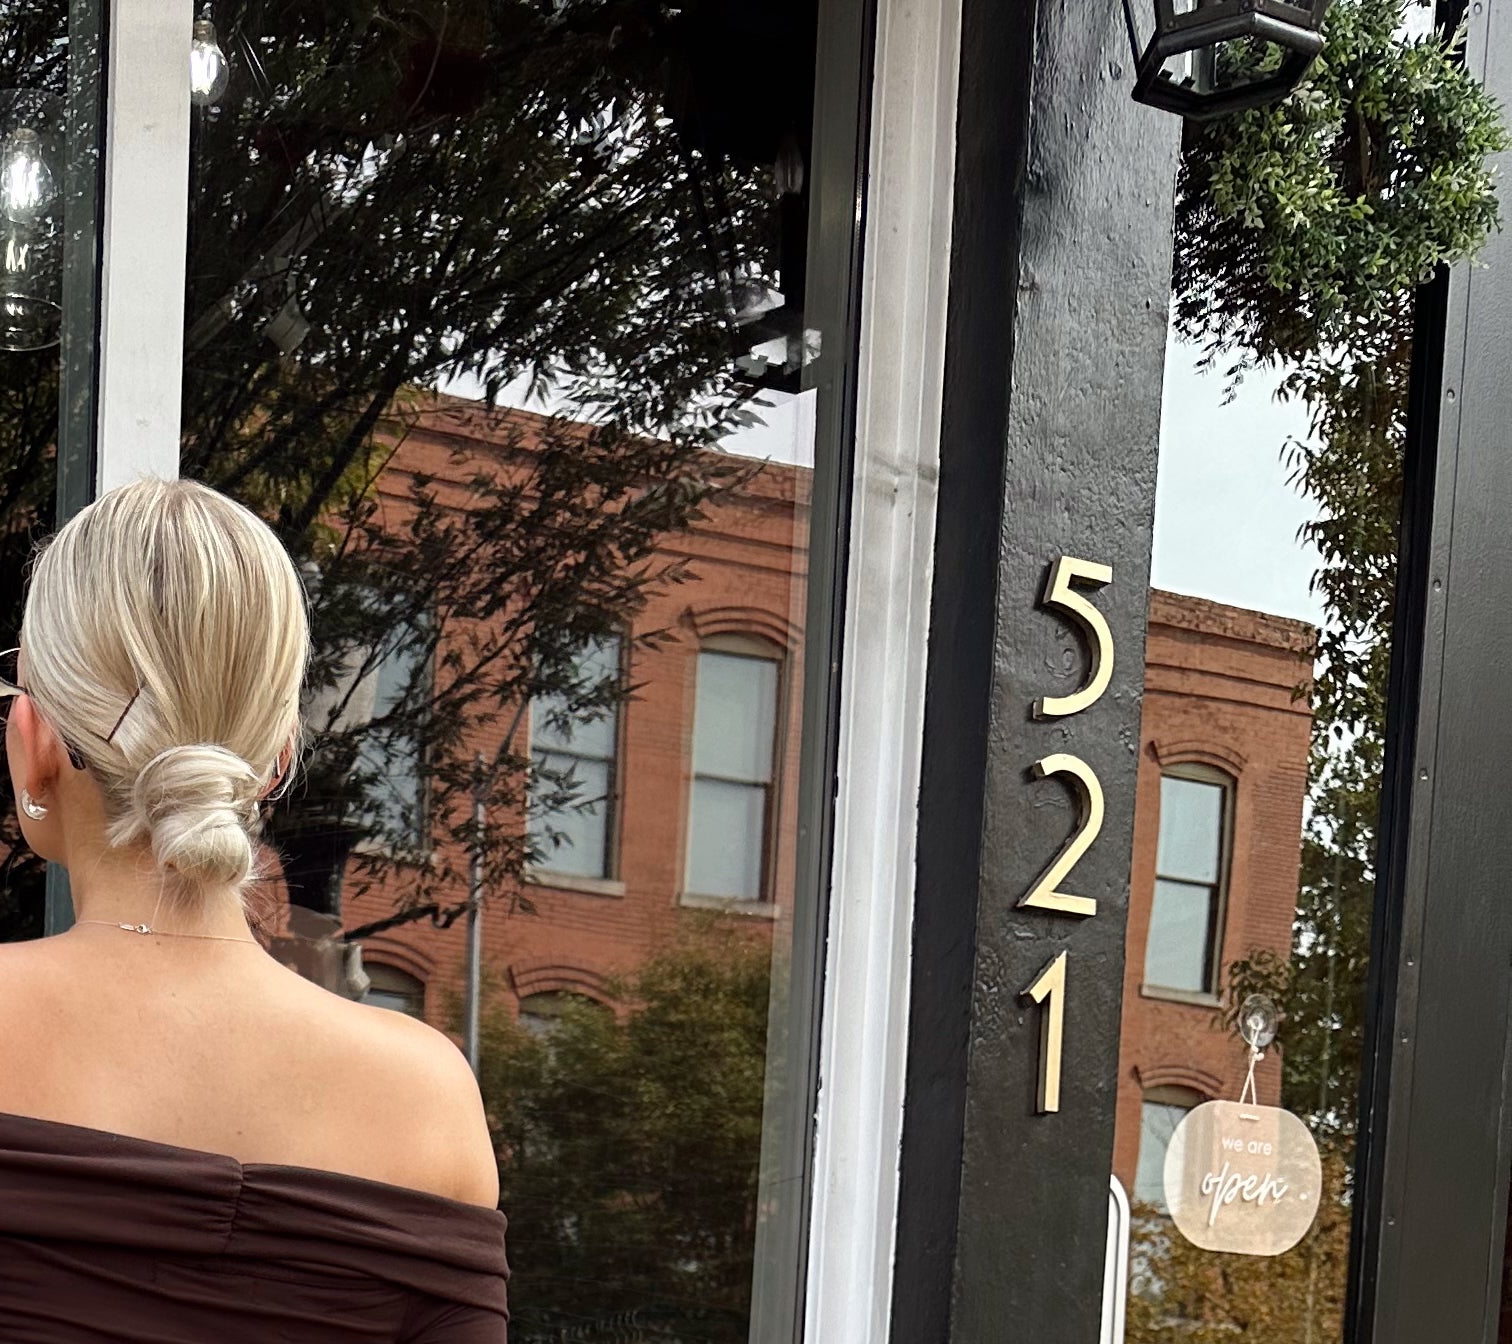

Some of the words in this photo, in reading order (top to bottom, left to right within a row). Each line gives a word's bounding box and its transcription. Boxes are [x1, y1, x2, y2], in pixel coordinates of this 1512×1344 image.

[1221, 1136, 1244, 1153] we
[1247, 1140, 1273, 1156] are
[1201, 1160, 1289, 1227] open
